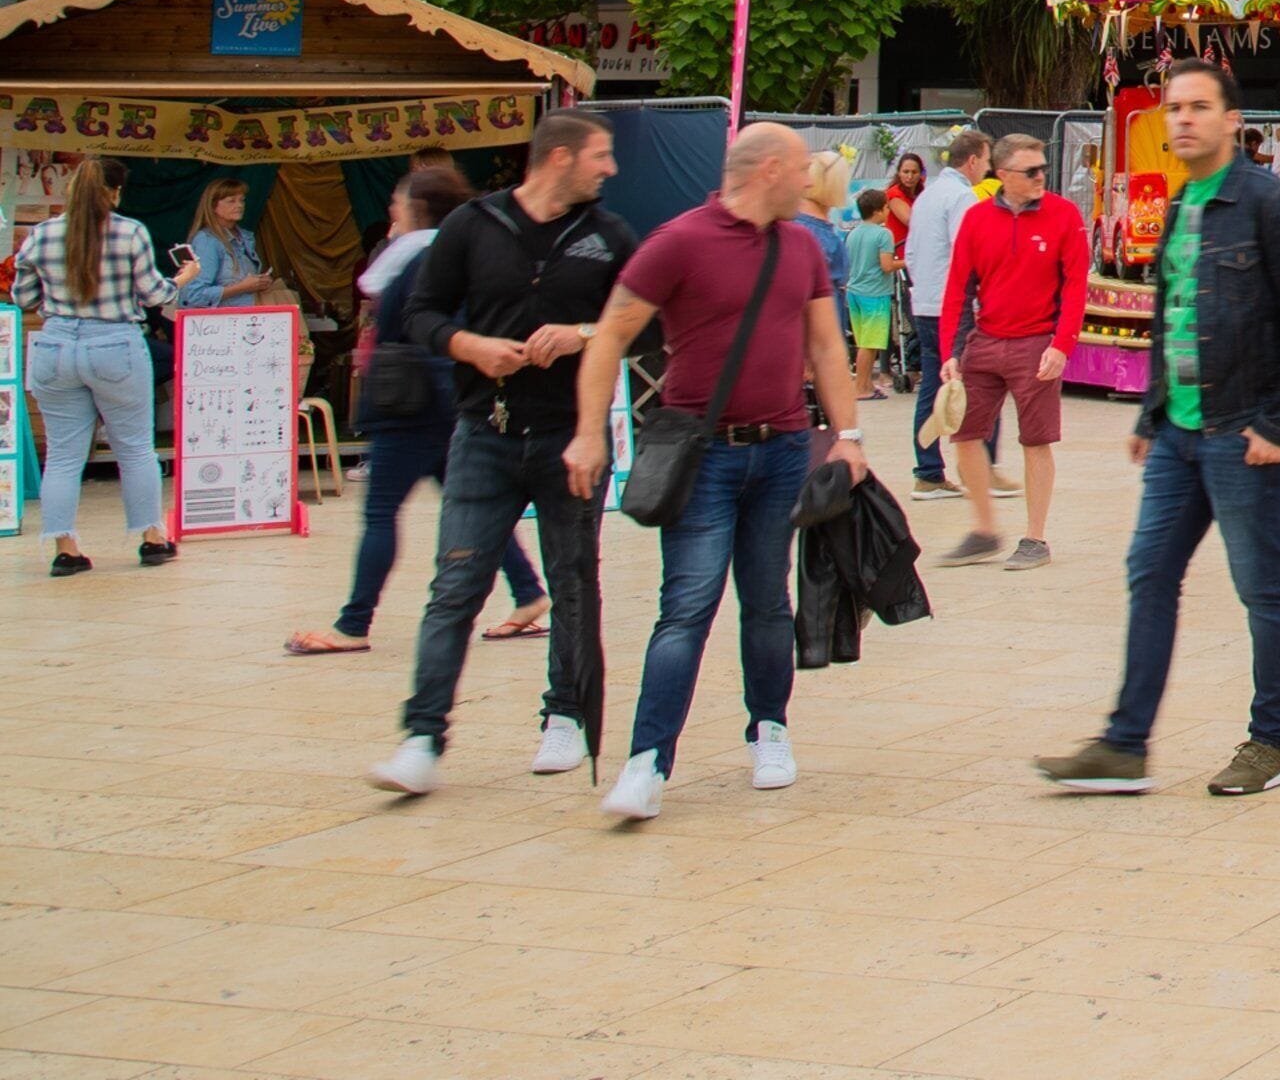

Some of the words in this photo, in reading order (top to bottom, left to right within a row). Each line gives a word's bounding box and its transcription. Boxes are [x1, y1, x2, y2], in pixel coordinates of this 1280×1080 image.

[238, 13, 281, 39] Live
[0, 94, 157, 140] ACE
[185, 96, 525, 150] PAINTING
